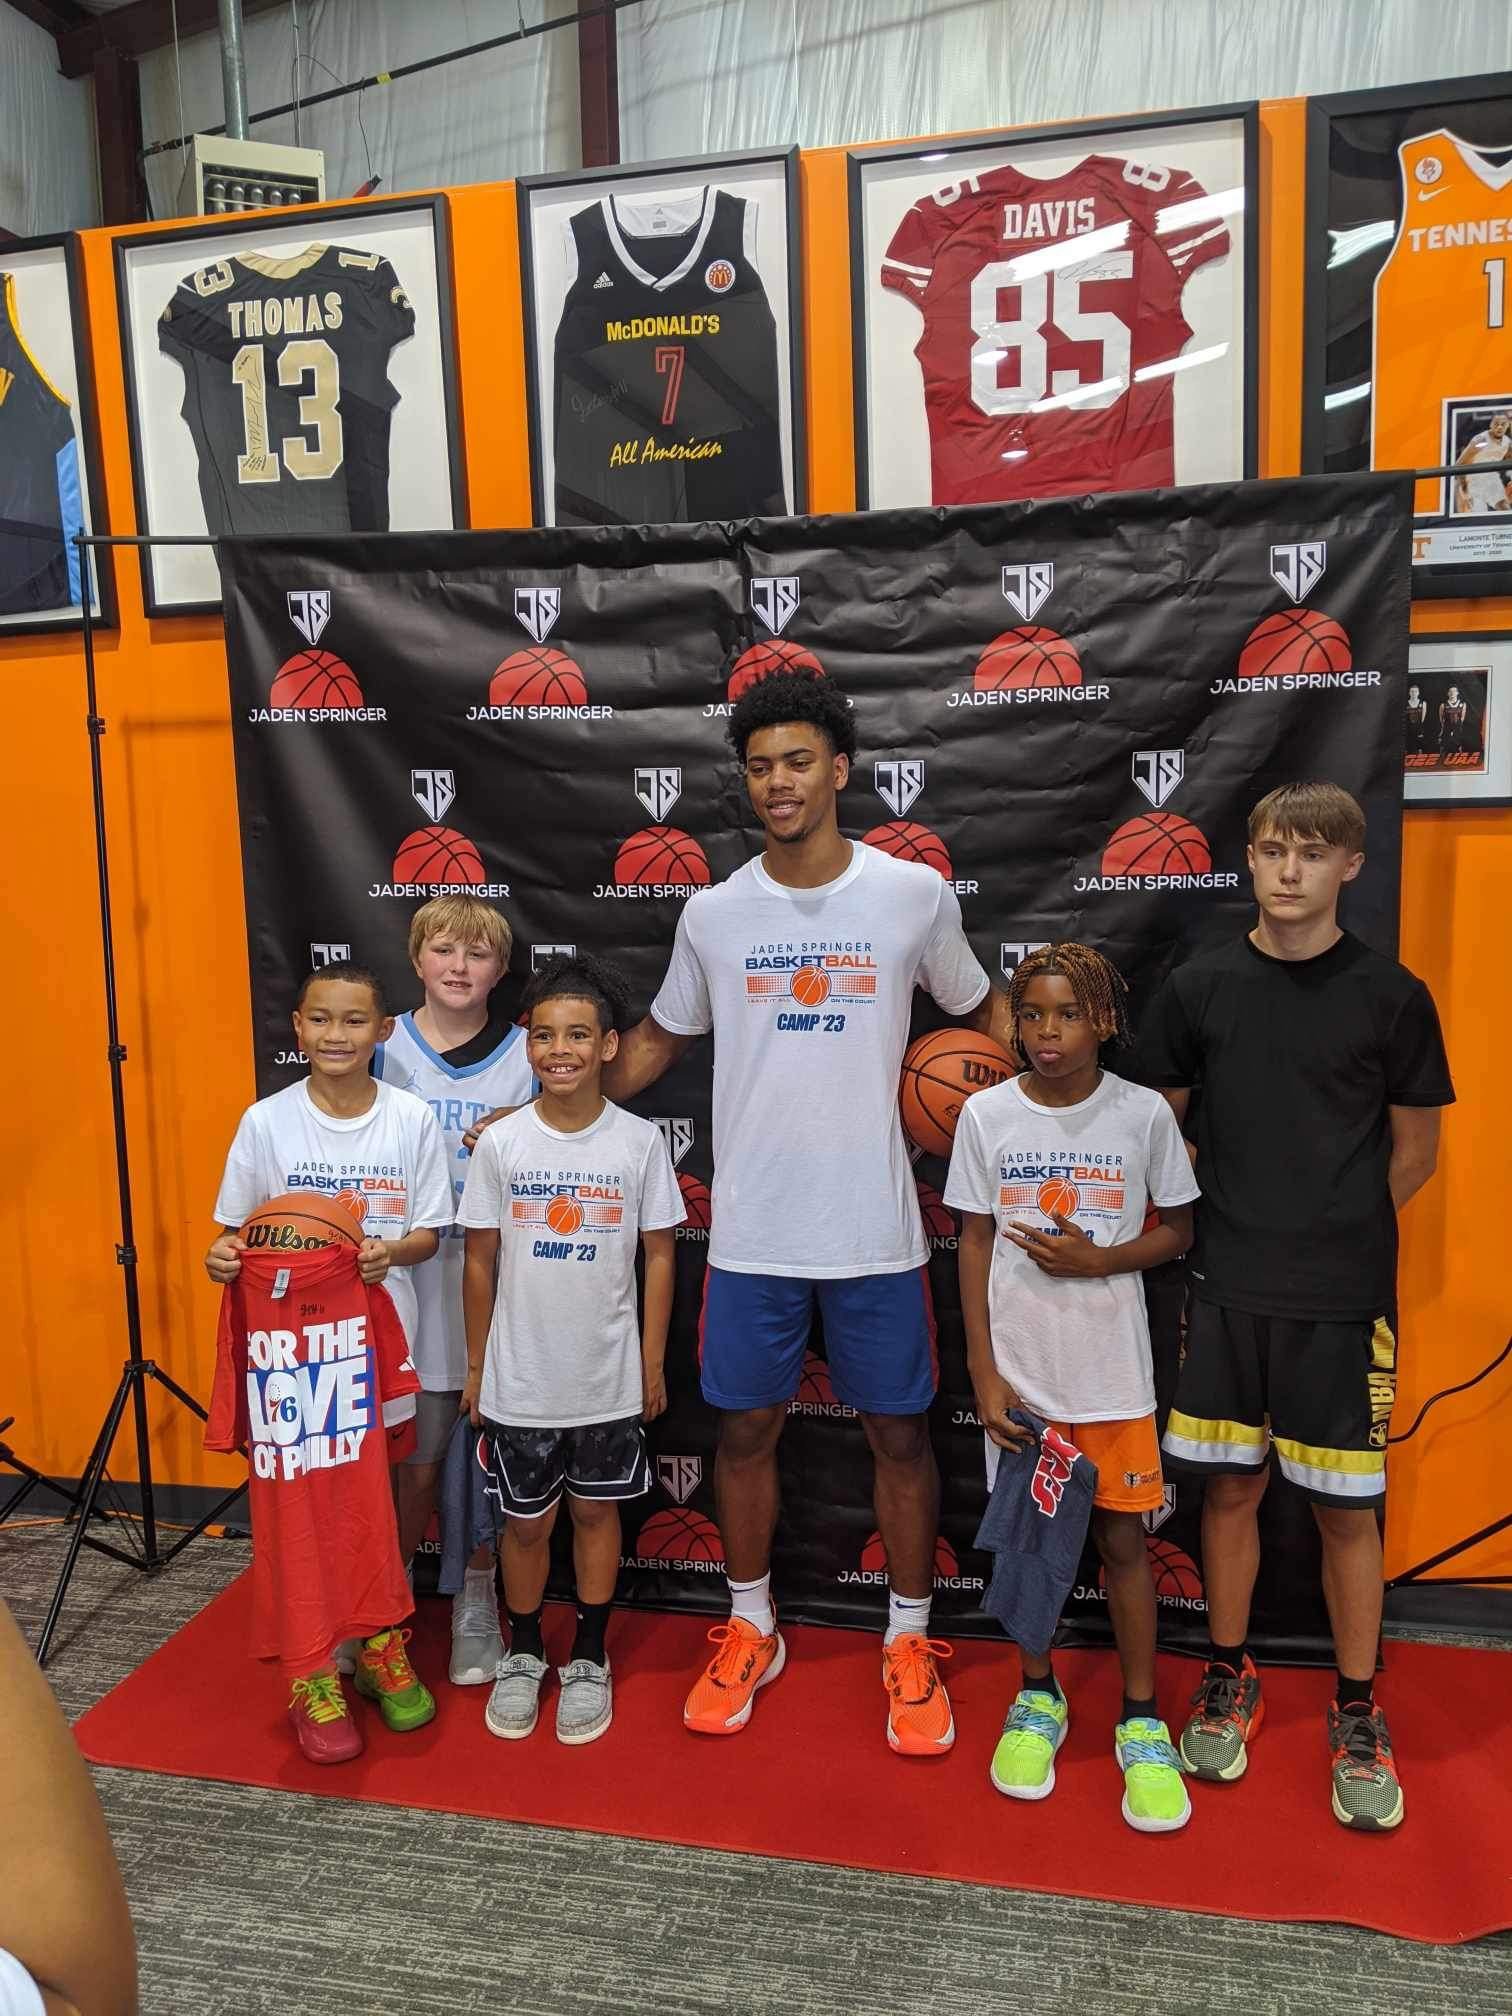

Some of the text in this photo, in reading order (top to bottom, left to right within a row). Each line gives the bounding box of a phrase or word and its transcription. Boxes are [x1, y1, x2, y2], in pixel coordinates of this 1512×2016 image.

[1002, 197, 1095, 240] DAVIS
[1408, 219, 1512, 252] TENNE
[1482, 257, 1506, 329] 1
[228, 291, 343, 338] THOMAS
[970, 250, 1134, 416] 85
[655, 345, 686, 425] 7
[232, 339, 344, 484] 13
[609, 436, 722, 468] All American
[1209, 671, 1382, 695] JADEN SPRINGER
[946, 685, 1111, 708] JADEN SPRINGER
[248, 708, 388, 722] JADEN SPRINGER
[466, 706, 613, 720] JADEN SPRINGER
[368, 884, 511, 898] JADEN SPRINGER
[593, 884, 712, 898] JADEN SPRIN
[1074, 873, 1239, 892] JADEN SPRINGER
[751, 942, 872, 954] JADEN SPRINGER
[745, 955, 878, 969] BASKETBALL
[777, 1013, 819, 1031] CAMP
[274, 1051, 310, 1064] JAD
[1002, 1152, 1123, 1166] JADEN SPRINGER
[294, 1161, 404, 1177] JADEN SPRINGER
[513, 1171, 621, 1185] JADEN SPRINGER
[1000, 1166, 1125, 1182] BASKETBALL
[287, 1175, 407, 1191] BASKETBALL
[511, 1183, 624, 1200] BASKETBALL
[533, 1240, 574, 1259] CAMP
[303, 1315, 367, 1363] THE
[247, 1356, 368, 1446] LOVE
[1368, 1372, 1396, 1423] NBA
[269, 1396, 298, 1423] 76
[786, 1402, 859, 1418] PRINGE
[254, 1427, 368, 1481] OF PHILLY
[618, 1558, 728, 1574] JADEN SPRIN
[932, 1577, 984, 1590] INGER
